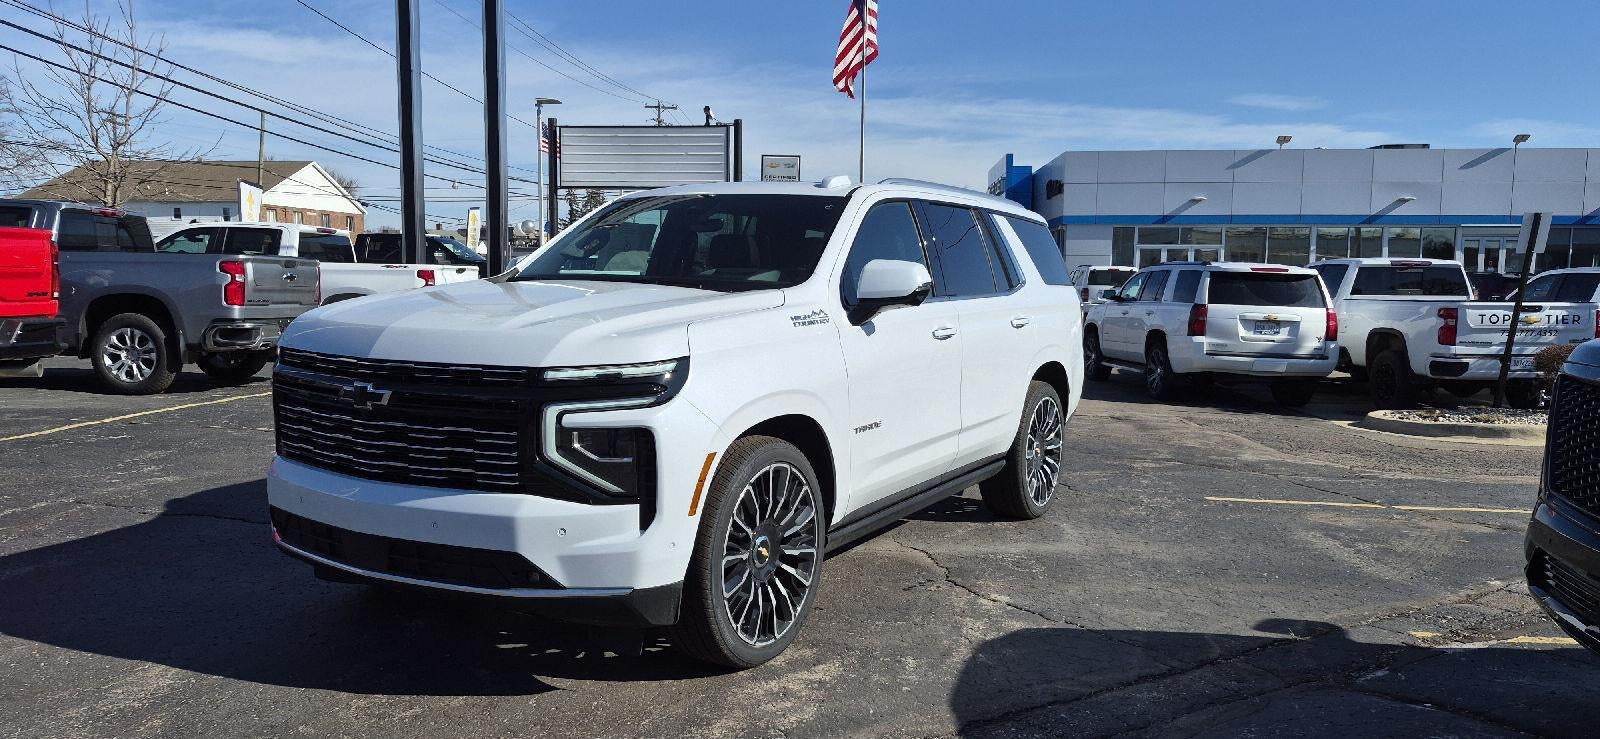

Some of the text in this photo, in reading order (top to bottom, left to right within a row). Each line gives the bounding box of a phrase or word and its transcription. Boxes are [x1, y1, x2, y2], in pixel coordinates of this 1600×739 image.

[793, 318, 829, 327] COUNTRY
[1478, 314, 1581, 325] TOP TIER
[854, 421, 882, 434] TAHOE
